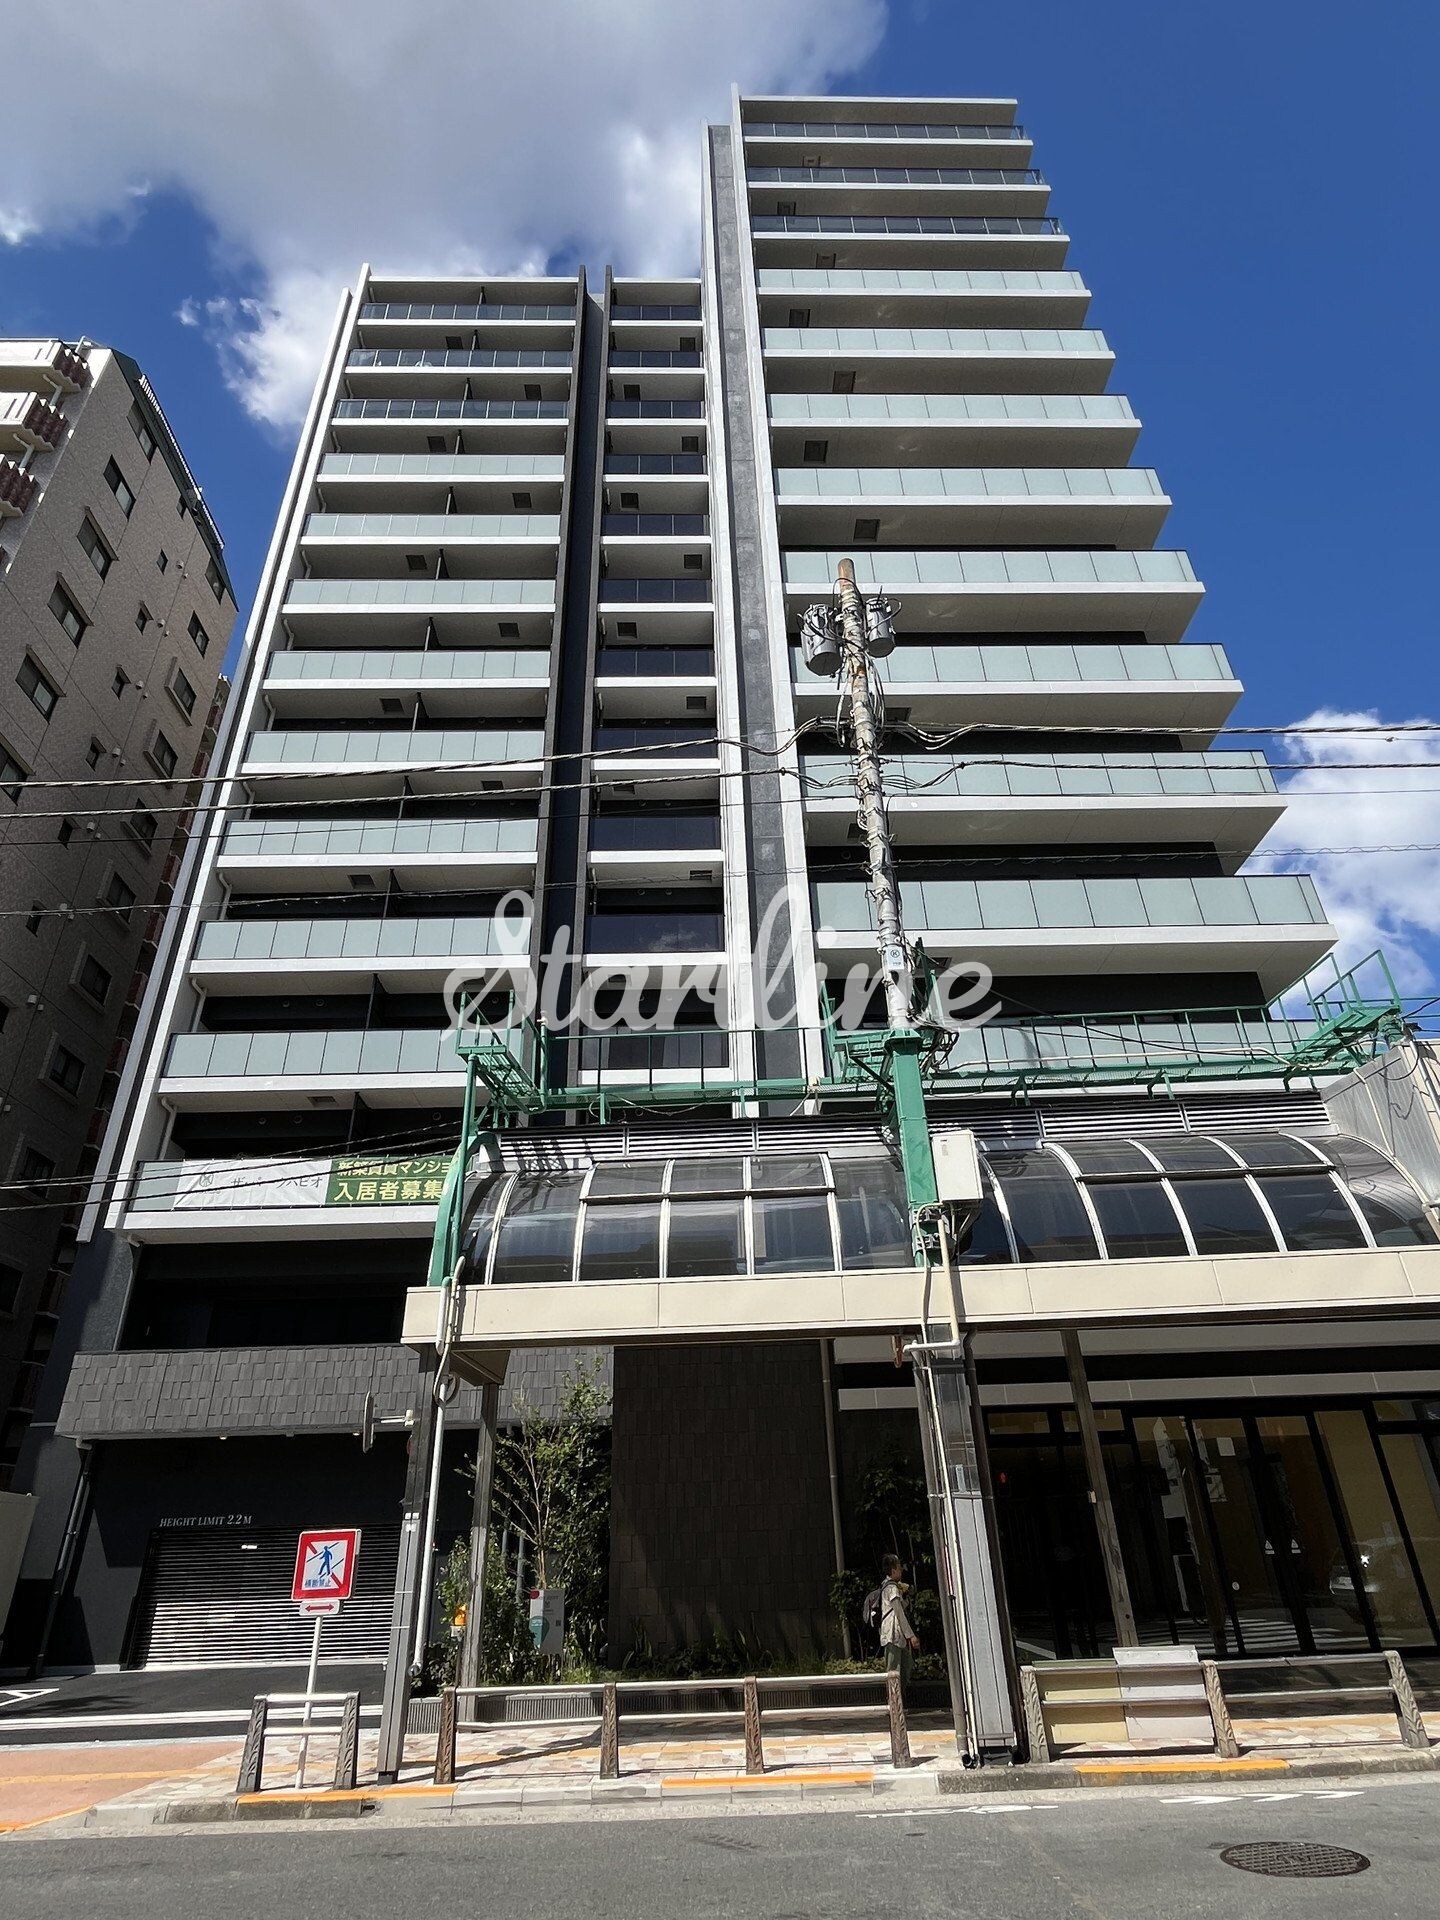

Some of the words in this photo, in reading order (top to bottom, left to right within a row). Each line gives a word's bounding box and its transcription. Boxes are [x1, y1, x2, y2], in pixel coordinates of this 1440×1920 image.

[333, 1179, 443, 1202] 入居者募集
[159, 1517, 197, 1528] HEIGHT
[197, 1516, 226, 1526] LIMIT
